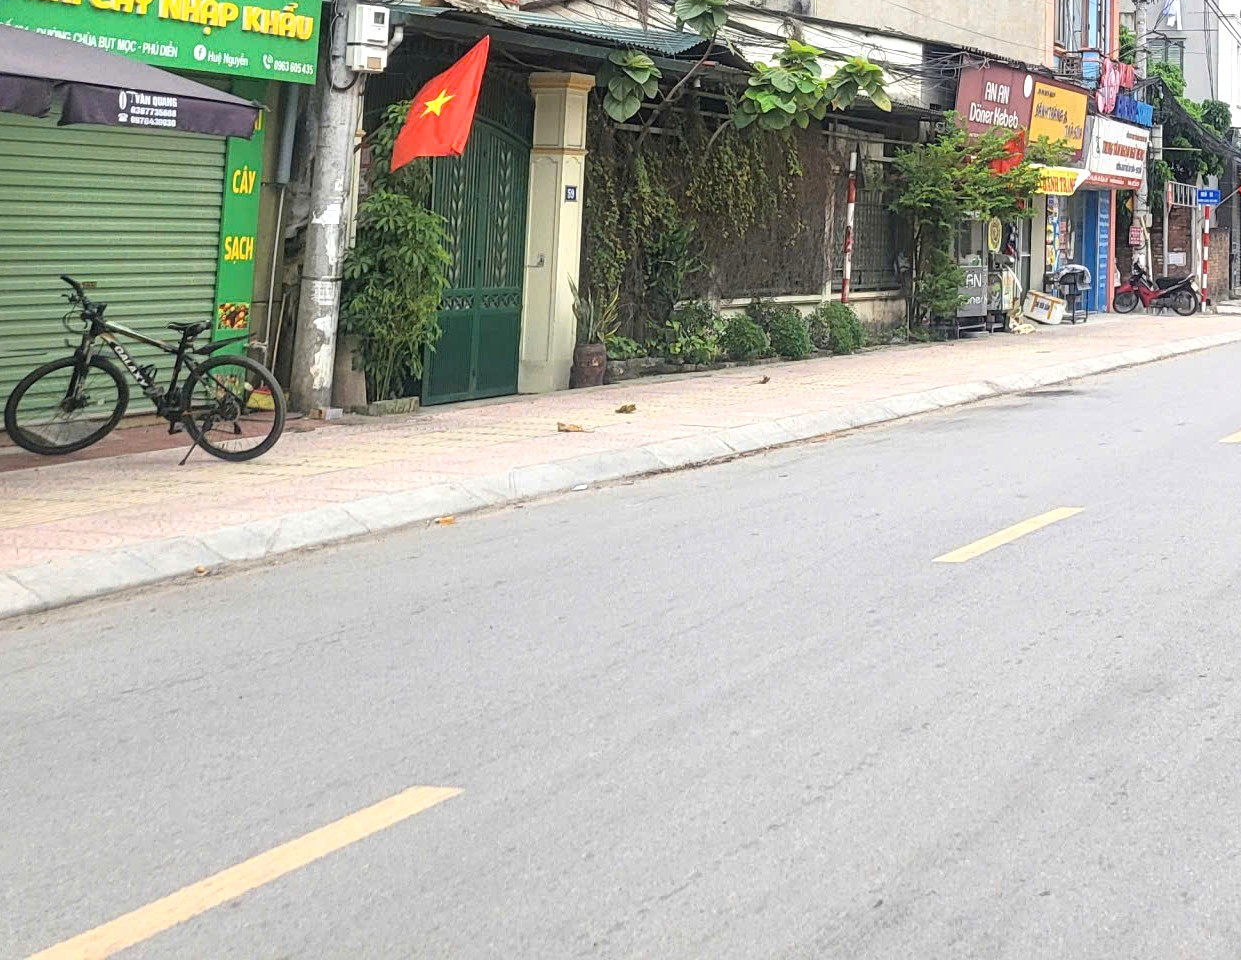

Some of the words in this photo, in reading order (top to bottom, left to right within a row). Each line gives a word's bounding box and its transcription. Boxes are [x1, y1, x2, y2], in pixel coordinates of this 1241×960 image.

[242, 2, 314, 40] KHẨU
[985, 81, 998, 102] AN
[997, 85, 1010, 104] AN
[969, 102, 994, 124] Döner
[232, 165, 256, 194] CÂY
[224, 236, 254, 264] SẠCH
[114, 346, 149, 386] GALAXY
